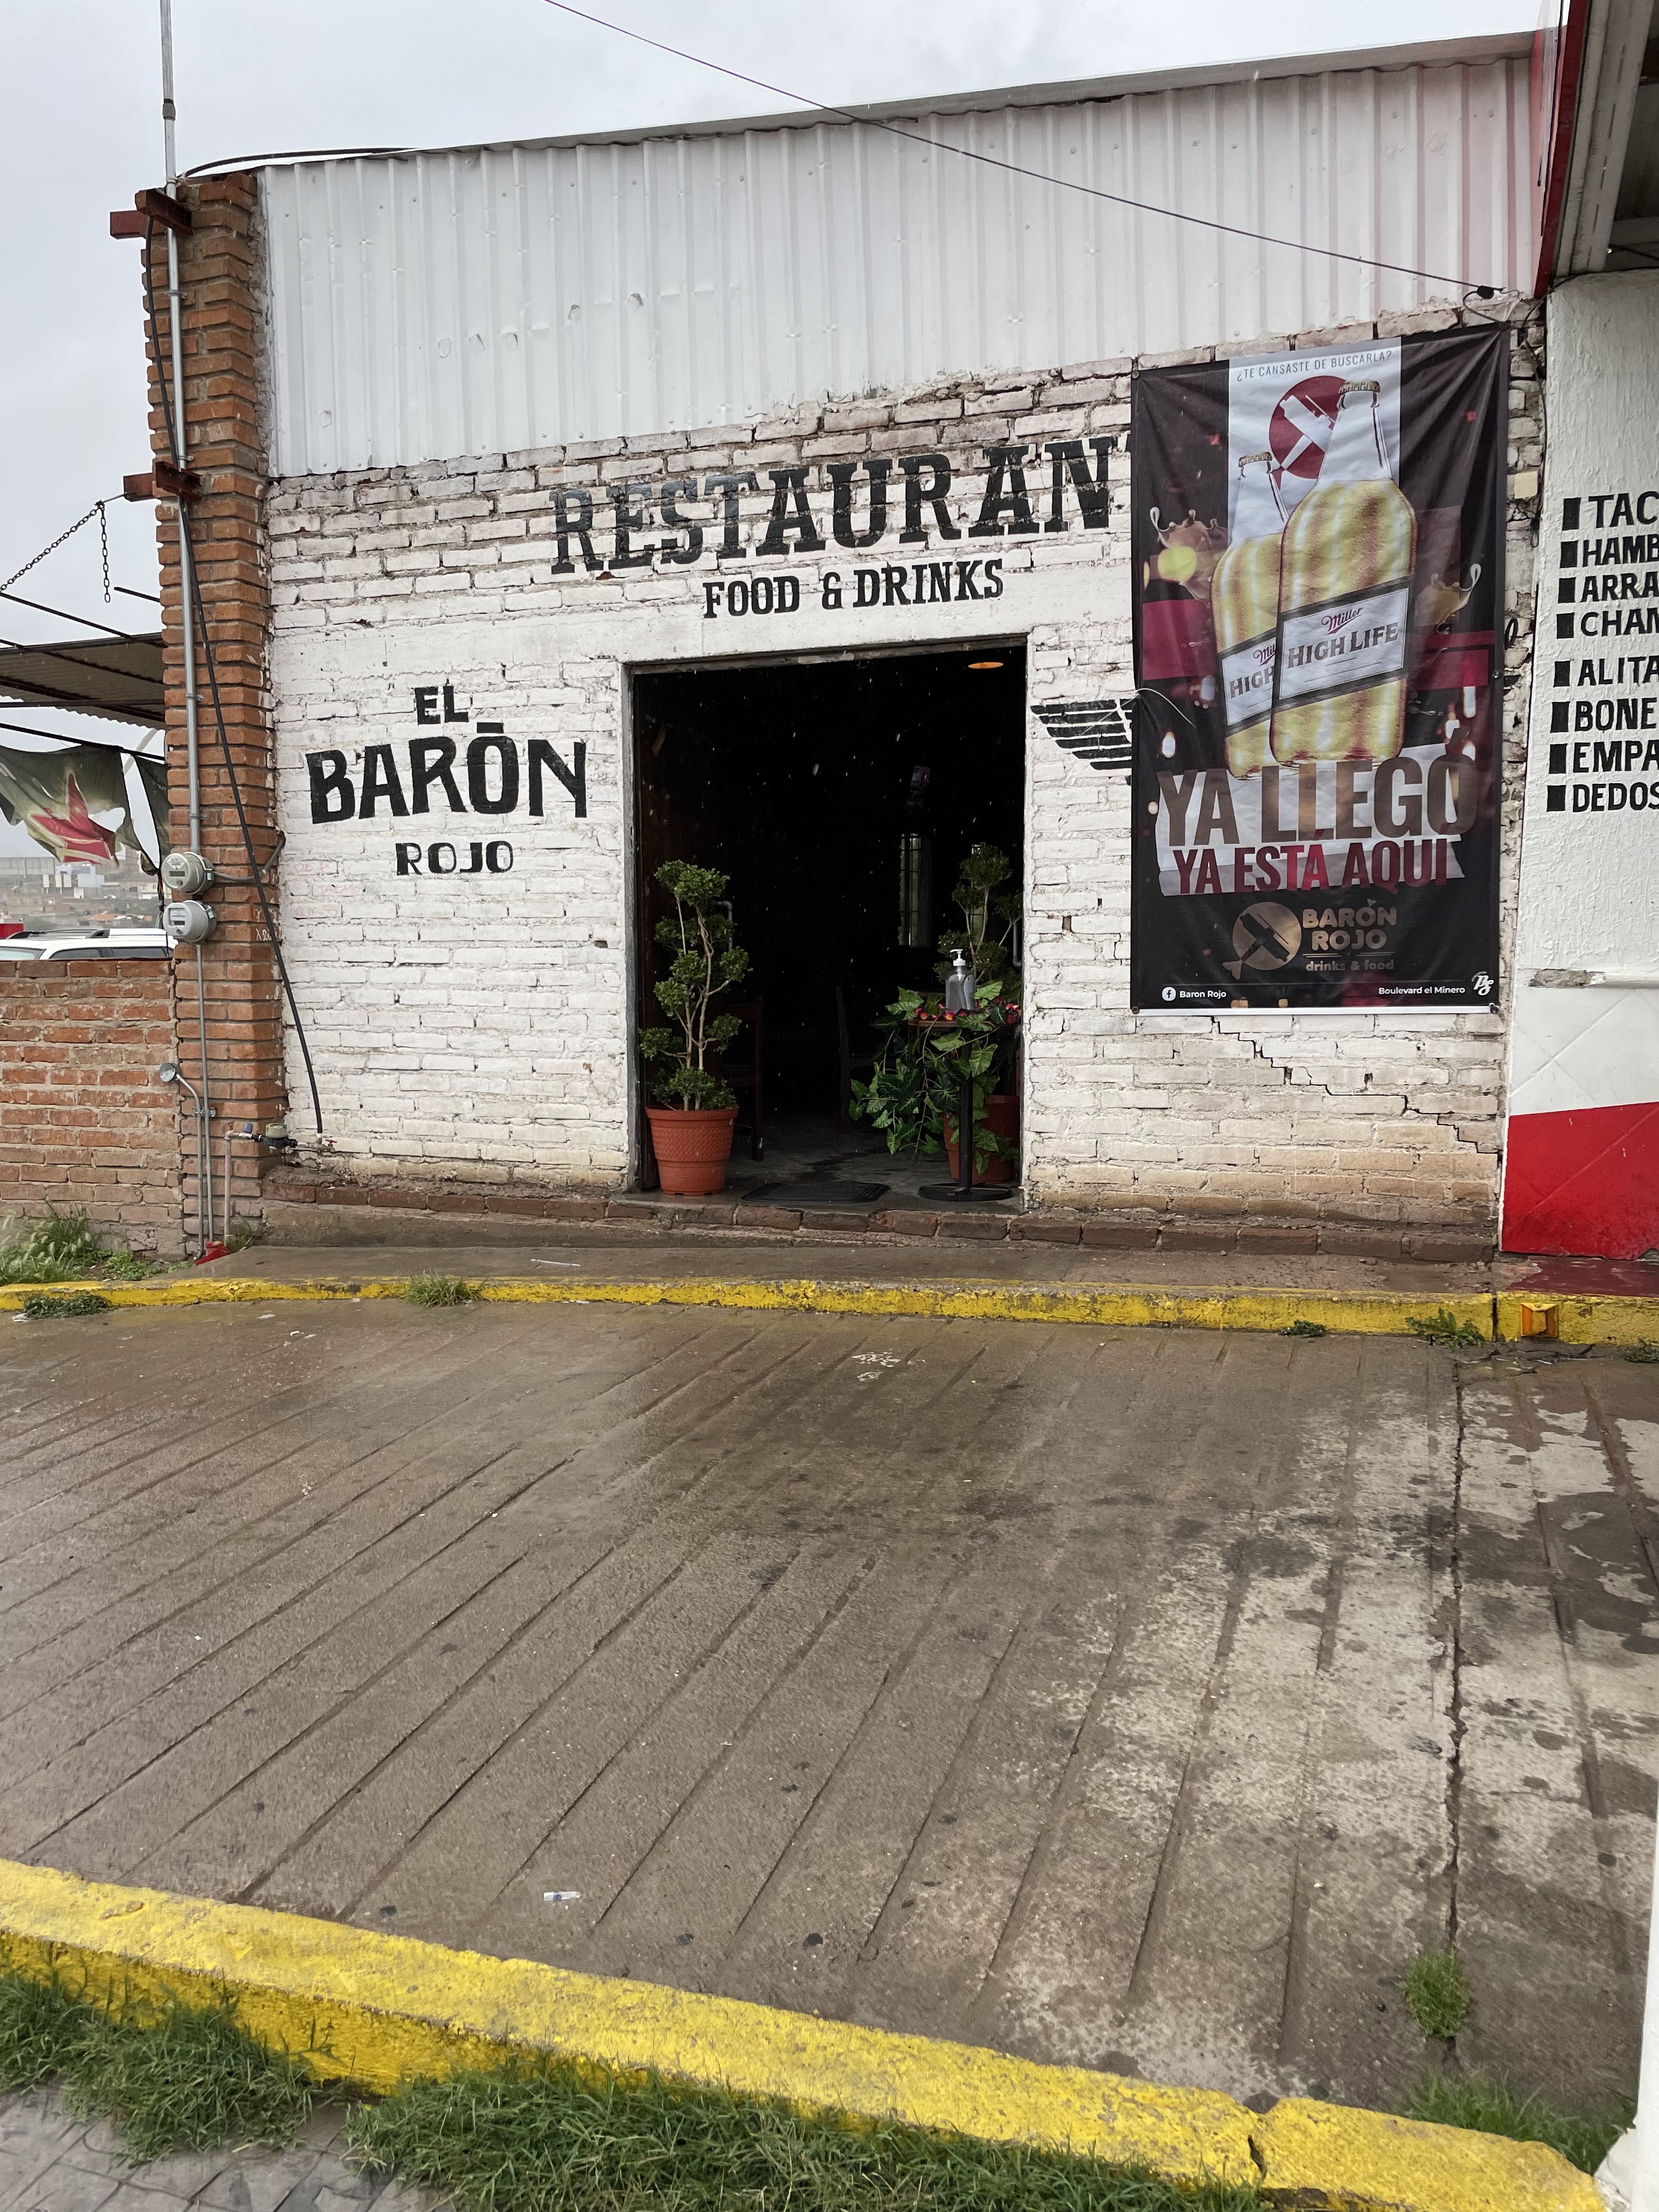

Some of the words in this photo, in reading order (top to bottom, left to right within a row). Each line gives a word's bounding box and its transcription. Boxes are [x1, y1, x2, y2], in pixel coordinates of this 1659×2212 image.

[1259, 360, 1310, 377] CANSASTE
[1314, 359, 1327, 370] DE
[1331, 350, 1392, 368] BUSCARLA?
[550, 436, 1131, 574] RESTAURAN
[1589, 491, 1659, 528] TAC
[1583, 534, 1659, 567] HAMB
[703, 575, 800, 619] FOOD
[822, 573, 843, 610] &
[853, 558, 1003, 607] DRINKS
[1580, 571, 1659, 603] ARRA
[1321, 607, 1364, 635] Miller
[1287, 636, 1346, 669] HIGH
[1350, 623, 1398, 652] LIFE
[1229, 666, 1274, 699] HIGH
[1577, 656, 1659, 686] ALITA
[414, 685, 469, 725] EL
[1574, 697, 1657, 732] BONE
[1572, 739, 1659, 773] EMPA
[1156, 769, 1240, 847] YA
[1572, 782, 1659, 812] DEDOS
[396, 840, 514, 876] ROJO
[1172, 848, 1223, 894] YA
[1312, 929, 1387, 951] ROJO
[1306, 961, 1346, 972] drinks
[1350, 961, 1359, 970] &
[1364, 960, 1394, 970] food
[1207, 990, 1227, 999] Rojo
